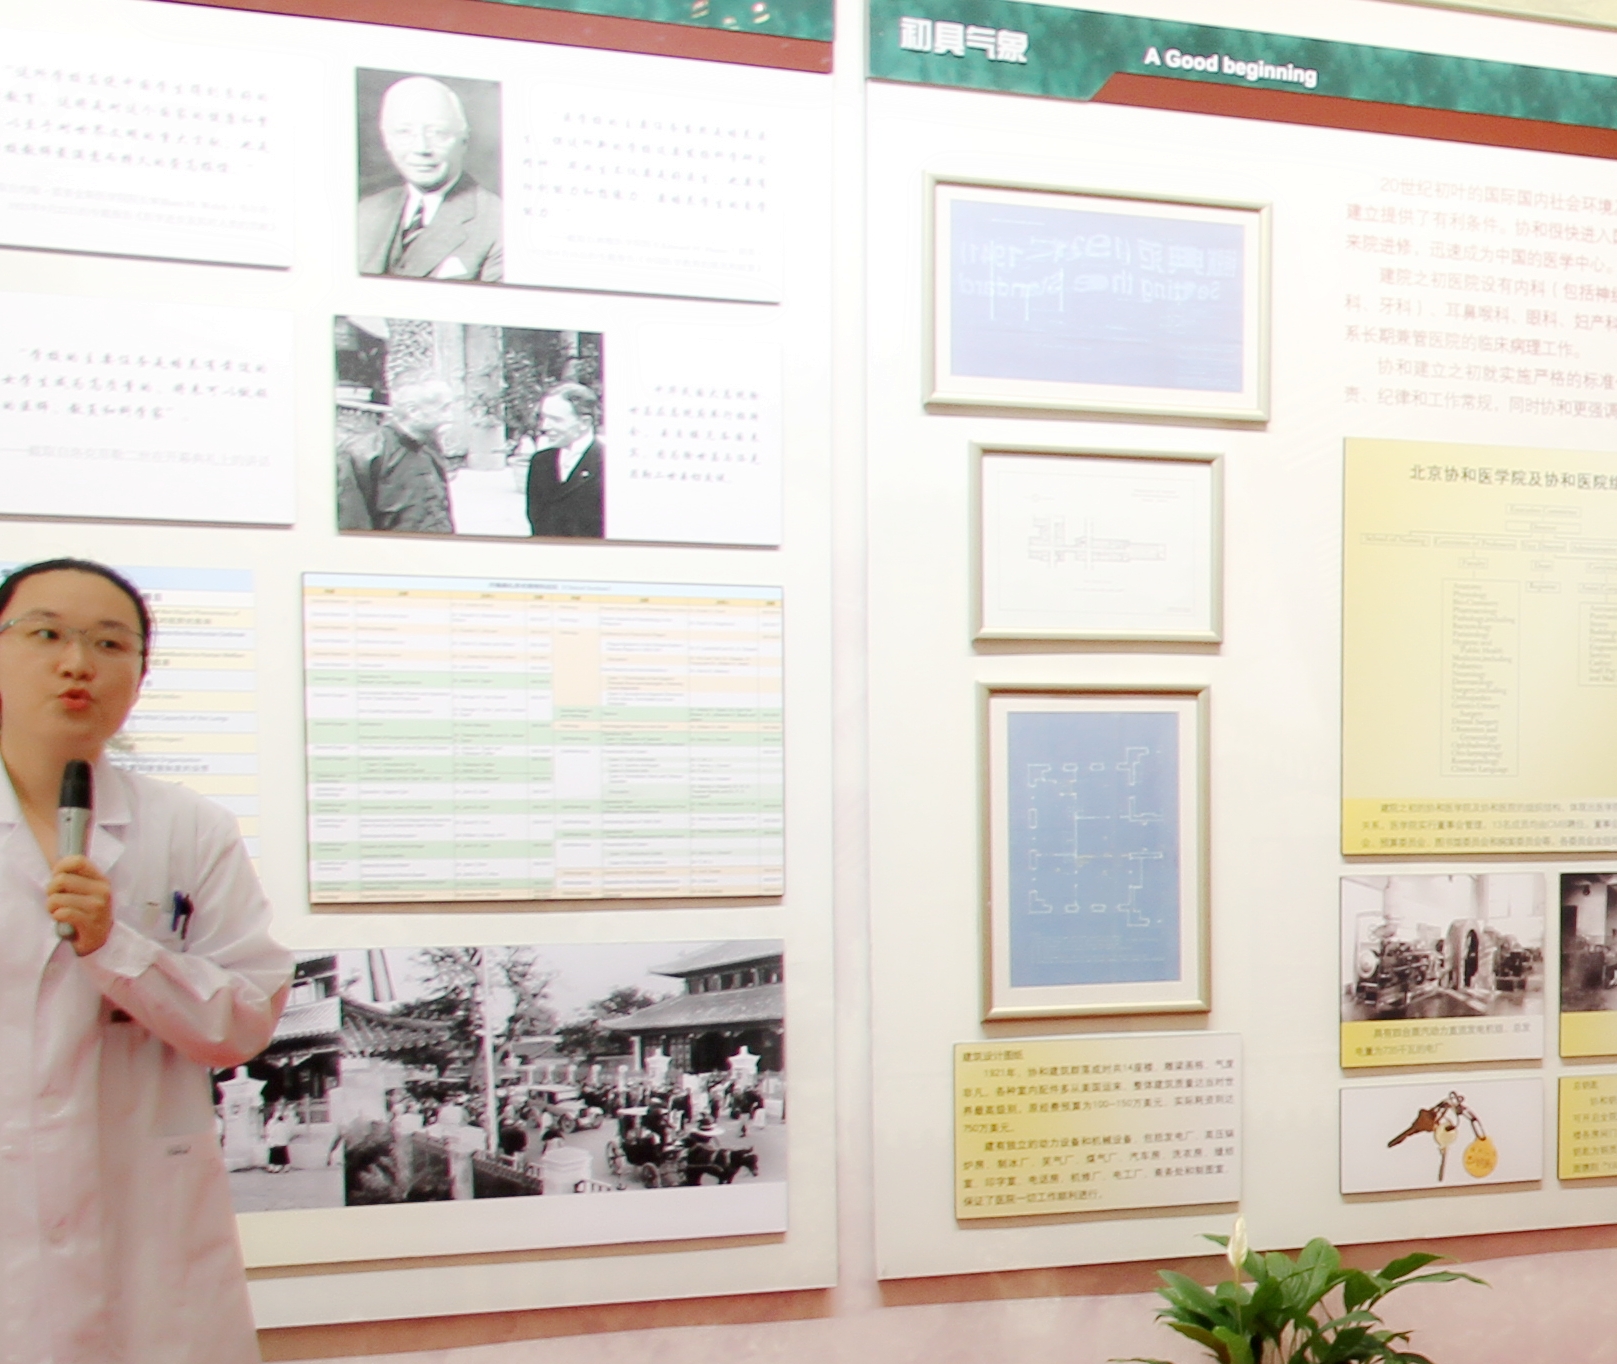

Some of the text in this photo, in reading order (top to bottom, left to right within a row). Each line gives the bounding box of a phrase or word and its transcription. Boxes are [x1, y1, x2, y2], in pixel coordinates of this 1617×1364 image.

[901, 15, 1029, 64] 初具气象
[1144, 47, 1318, 88] A Good beginning
[962, 1048, 1024, 1062] 建筑设计图纸
